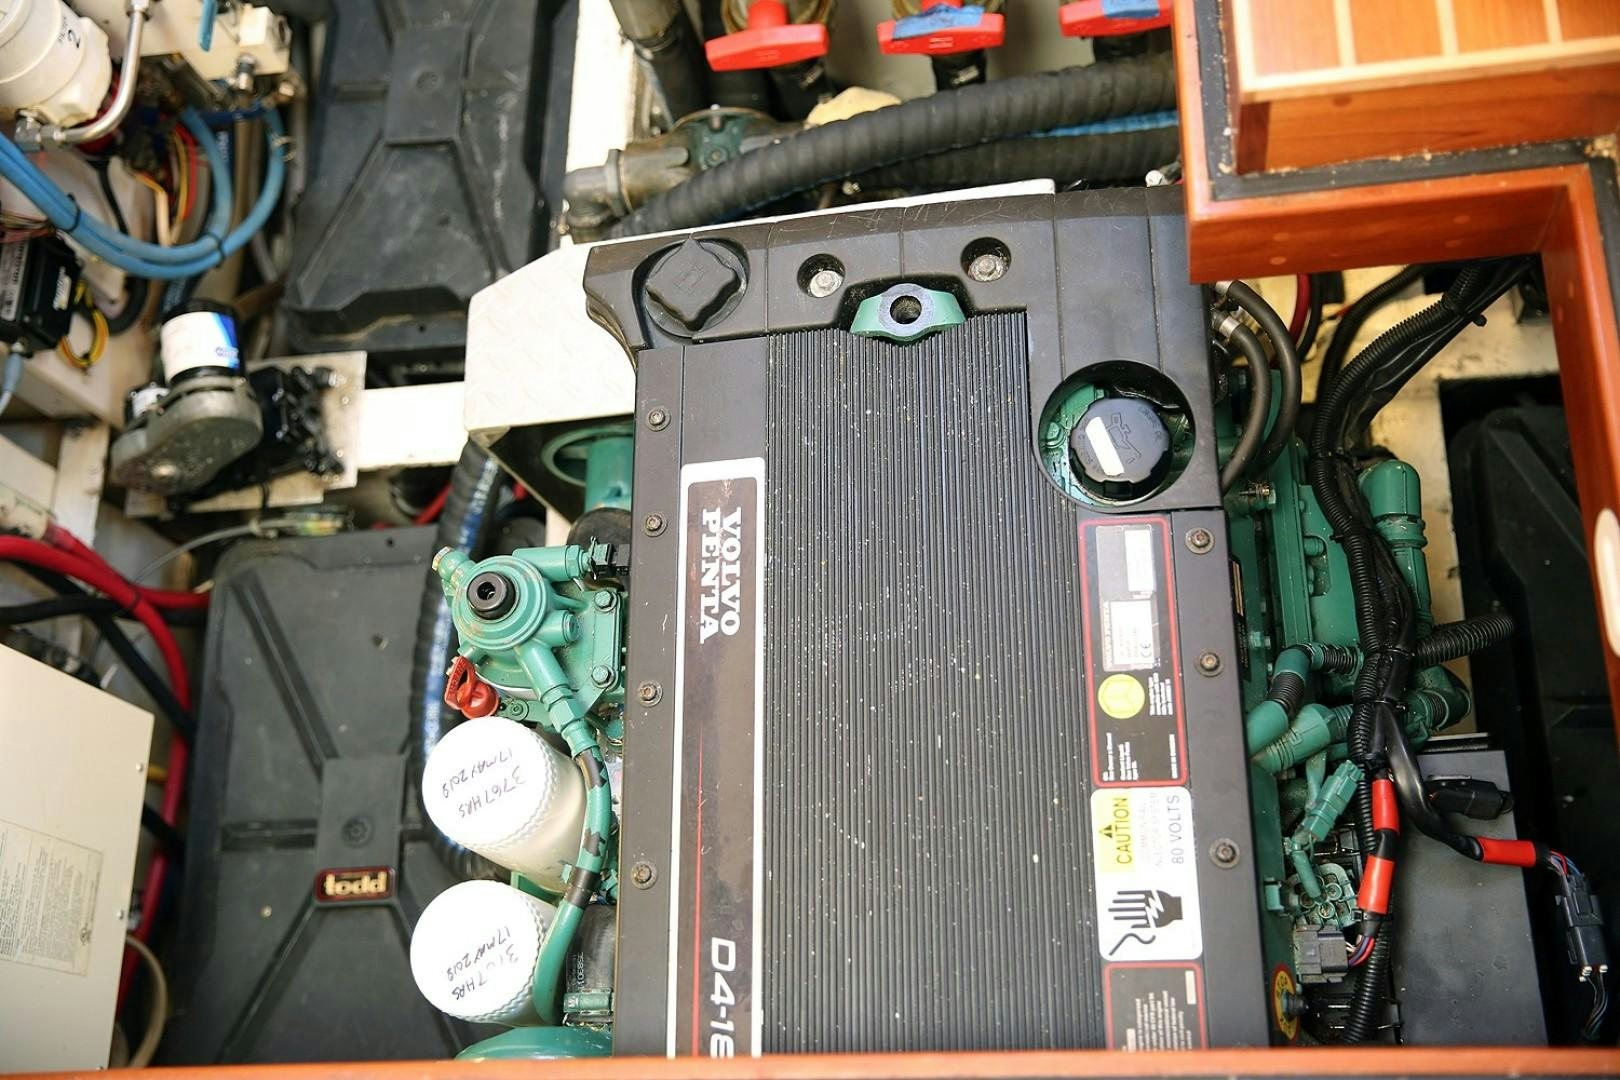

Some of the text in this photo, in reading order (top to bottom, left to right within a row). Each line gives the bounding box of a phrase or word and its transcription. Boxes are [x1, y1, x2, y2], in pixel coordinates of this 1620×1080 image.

[700, 507, 721, 645] PENTA
[720, 507, 742, 636] VOLVO
[1113, 797, 1132, 864] CAUTION
[1166, 794, 1183, 842] VOLTS
[324, 871, 387, 896] todd
[1170, 847, 1185, 864] 80
